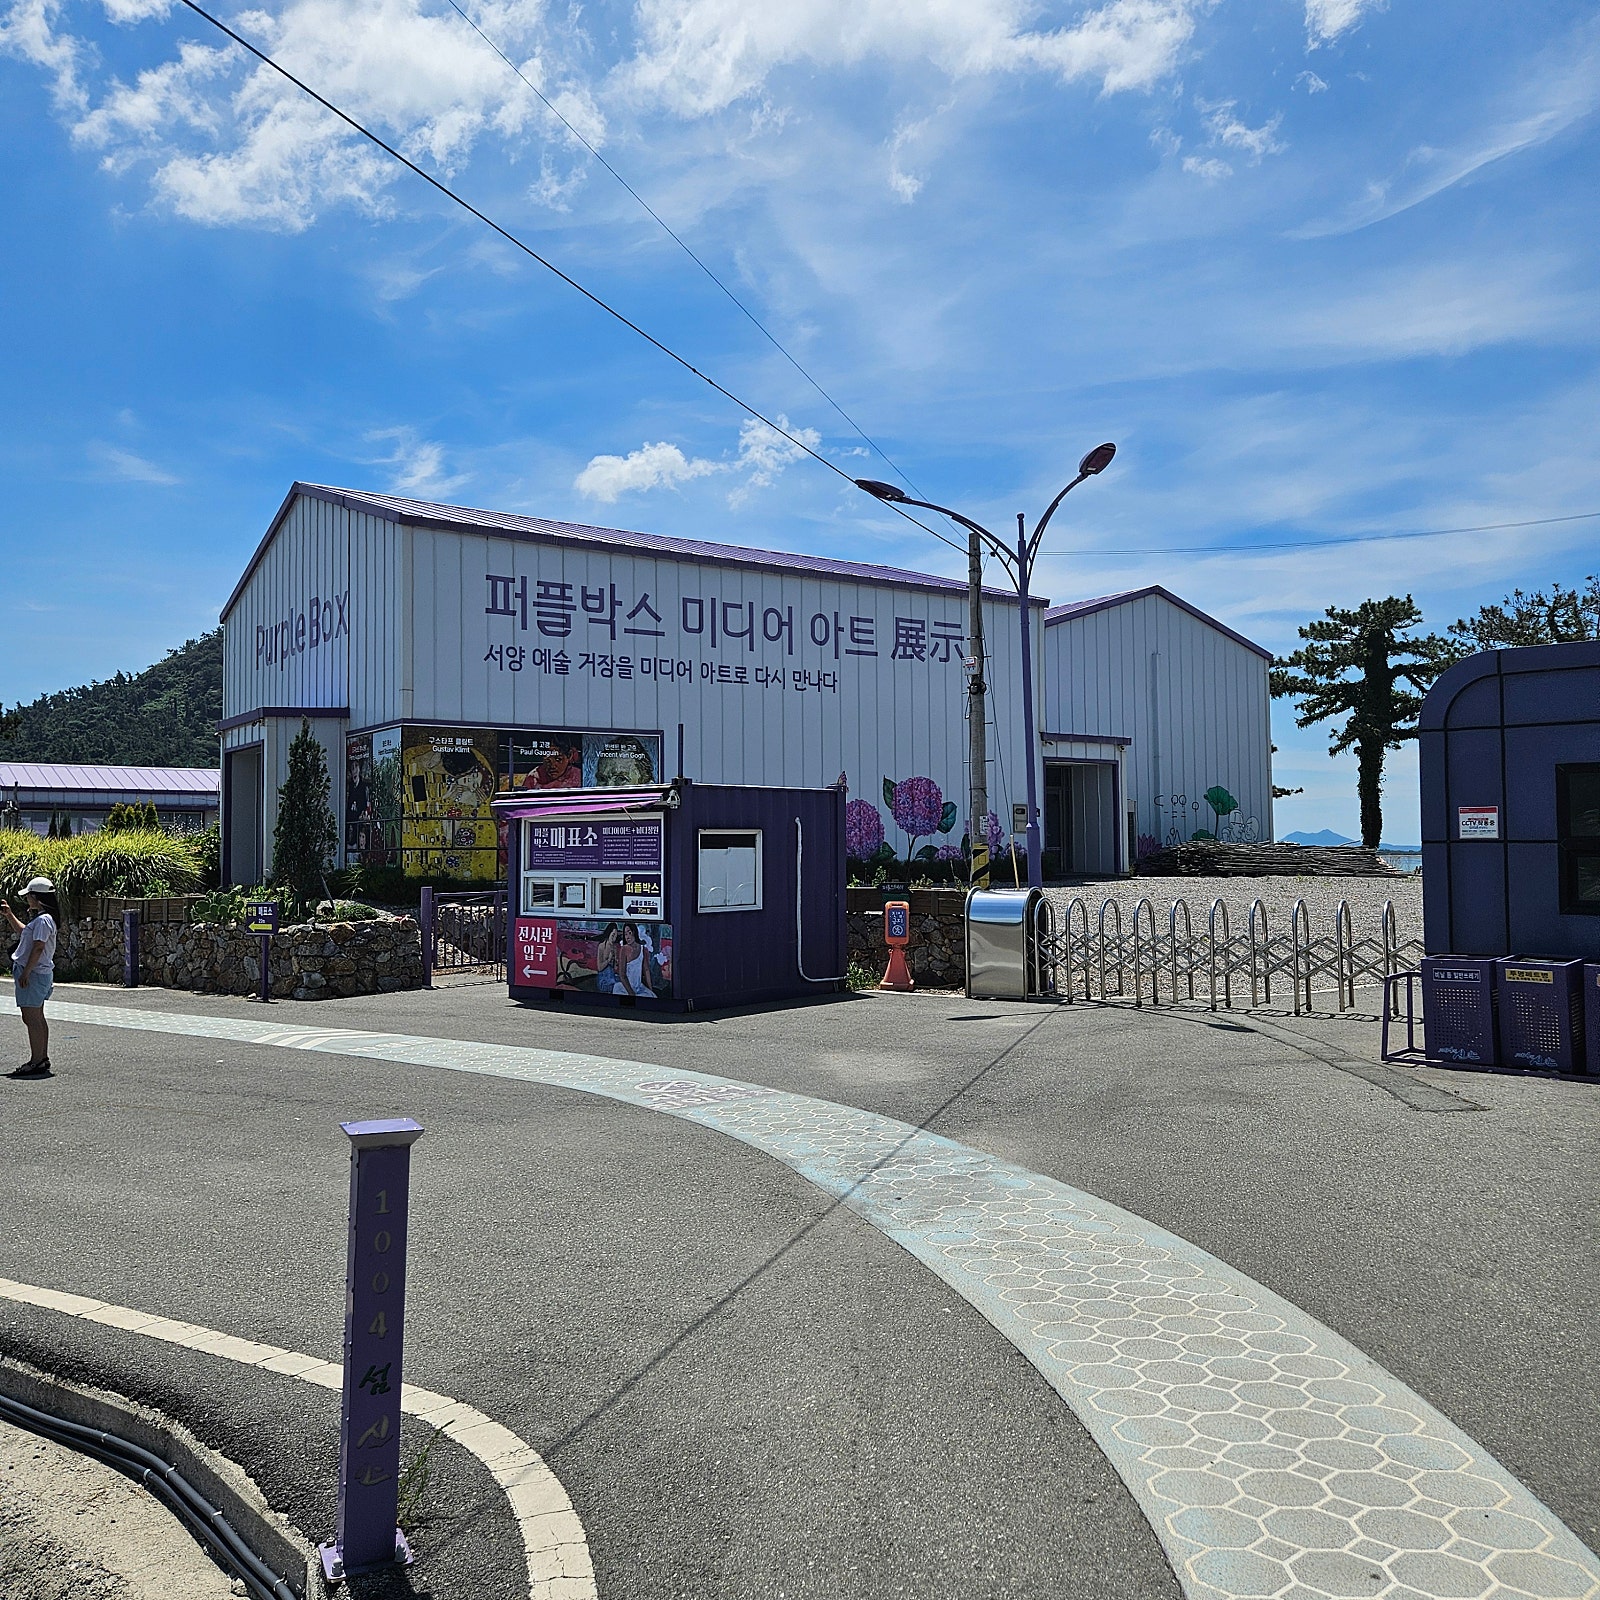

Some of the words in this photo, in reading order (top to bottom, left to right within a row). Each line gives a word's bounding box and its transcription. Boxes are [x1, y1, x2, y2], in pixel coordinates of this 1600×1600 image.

[484, 574, 666, 641] 퍼플박스
[682, 597, 794, 656] 미디어
[810, 611, 879, 660] 아트
[890, 616, 966, 663] 展示
[256, 607, 306, 672] Purple
[483, 644, 526, 672] 서양
[532, 648, 572, 676] 예술
[578, 652, 635, 680] 거장을
[640, 657, 693, 684] 미디어
[700, 660, 750, 685] 아트로
[755, 665, 786, 690] 다시
[792, 668, 838, 694] 만나다
[432, 745, 455, 753] Gustav
[519, 748, 534, 756] Paul
[534, 749, 559, 758] Gauguin
[595, 750, 618, 758] Vincent
[630, 752, 646, 760] Gogh
[550, 826, 599, 849] 매표소
[625, 882, 660, 894] 퍼플박스
[518, 926, 553, 944] 전시관
[523, 945, 547, 962] 입구
